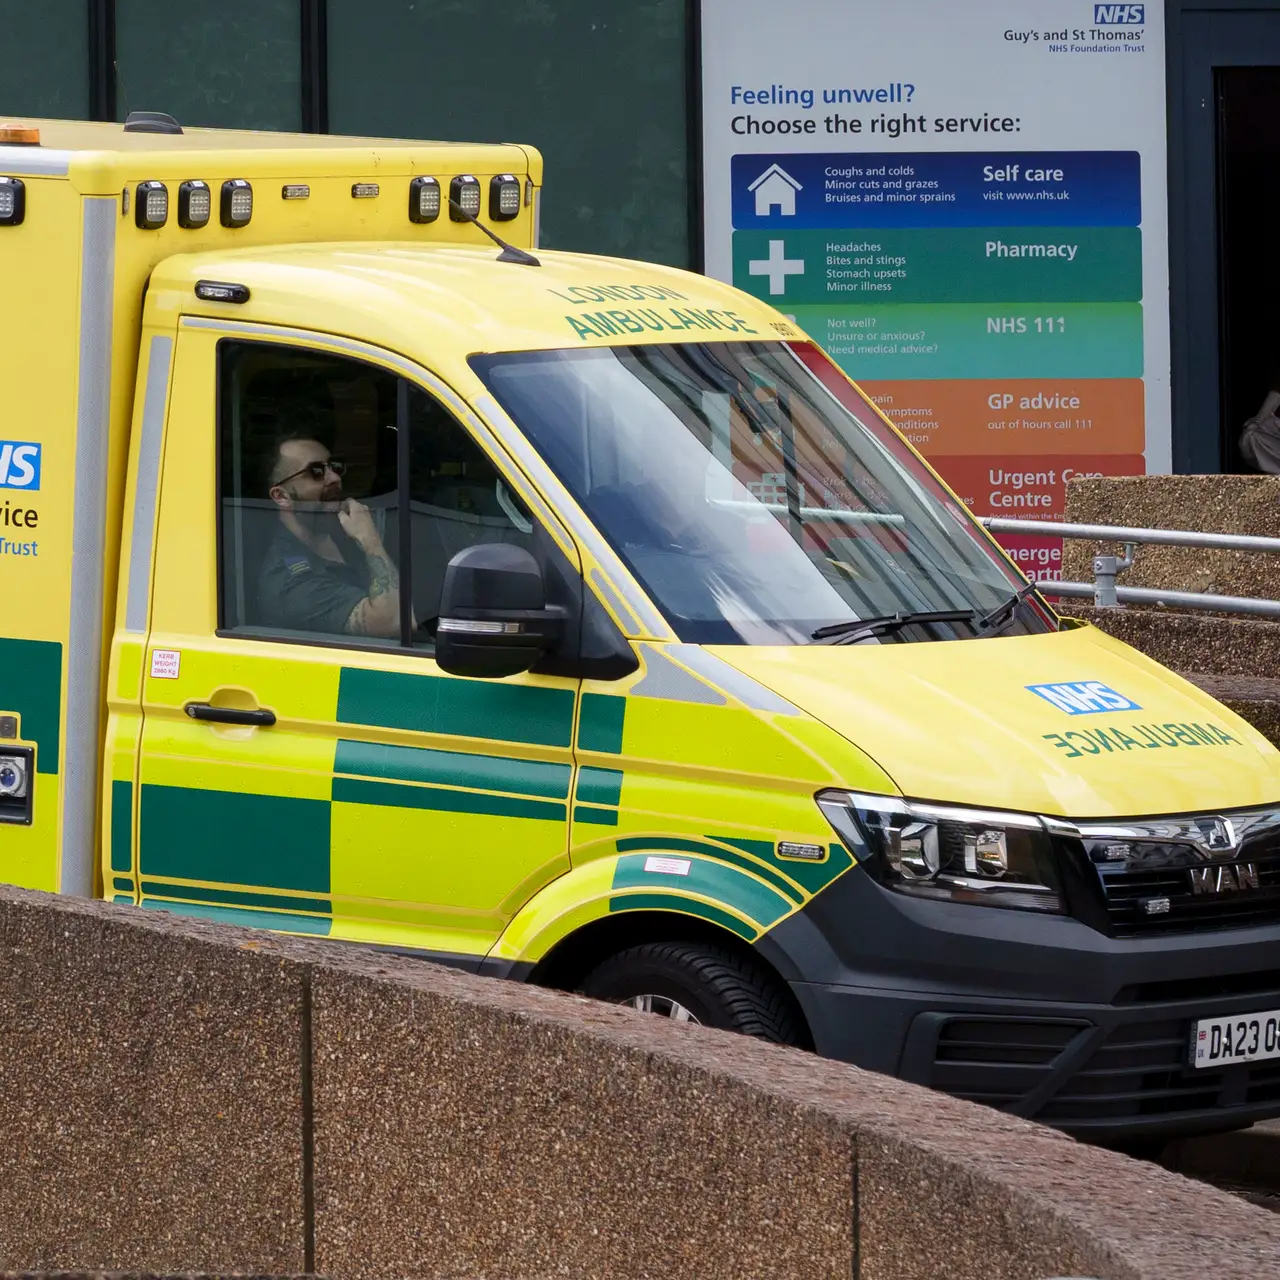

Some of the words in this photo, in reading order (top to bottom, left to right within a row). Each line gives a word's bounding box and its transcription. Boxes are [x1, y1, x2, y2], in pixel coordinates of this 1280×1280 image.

[1095, 5, 1144, 24] NHS
[1004, 29, 1039, 43] Guy's
[1043, 29, 1067, 41] and
[1072, 29, 1085, 41] St
[1089, 29, 1144, 41] Thomas'
[1049, 44, 1068, 53] NHS
[1070, 44, 1121, 53] Foundation
[1123, 44, 1145, 53] Trust
[731, 84, 814, 108] Feeling
[823, 83, 915, 104] unwell?
[731, 115, 816, 135] Choose
[824, 114, 862, 134] the
[871, 113, 927, 138] right
[934, 112, 1021, 133] service:
[825, 166, 863, 178] Coughs
[866, 166, 886, 177] and
[888, 165, 914, 176] colds
[983, 165, 1019, 182] Self
[1025, 169, 1064, 182] care
[825, 179, 857, 190] Minor
[859, 179, 880, 190] cuts
[882, 179, 903, 189] and
[905, 180, 938, 192] grazes
[825, 192, 861, 203] Bruises
[864, 192, 884, 202] and
[886, 191, 917, 202] minor
[919, 191, 956, 204] sprains
[983, 190, 1003, 200] visit
[1006, 190, 1069, 201] www.nhs.uk
[826, 242, 882, 253] Headaches
[985, 241, 1078, 261] Pharmacy
[826, 255, 852, 266] Bites
[854, 255, 874, 266] and
[876, 255, 906, 268] stings
[826, 268, 870, 279] Stomach
[873, 268, 906, 281] upsets
[546, 284, 688, 304] LONDON
[827, 281, 858, 292] Minor
[860, 281, 892, 292] illness
[564, 308, 760, 341] AMBULANCE
[827, 318, 848, 329] Not
[850, 318, 876, 328] well?
[987, 317, 1027, 334] NHS
[1034, 317, 1066, 333] 111
[827, 331, 864, 342] Unsure
[866, 333, 878, 342] or
[880, 330, 925, 341] anxious?
[827, 344, 855, 355] Need
[857, 344, 898, 355] medical
[900, 343, 938, 354] advice?
[988, 393, 1013, 410] GP
[1019, 392, 1080, 410] advice
[988, 420, 1006, 430] out
[1008, 419, 1020, 430] of
[1022, 419, 1051, 430] hours
[1054, 419, 1072, 429] call
[1075, 419, 1092, 429] 111
[989, 469, 1056, 489] Urgent
[989, 491, 1052, 507] Centre
[1031, 682, 1135, 714] NHS
[1190, 863, 1259, 895] MAN
[1209, 1020, 1260, 1060] DA23
